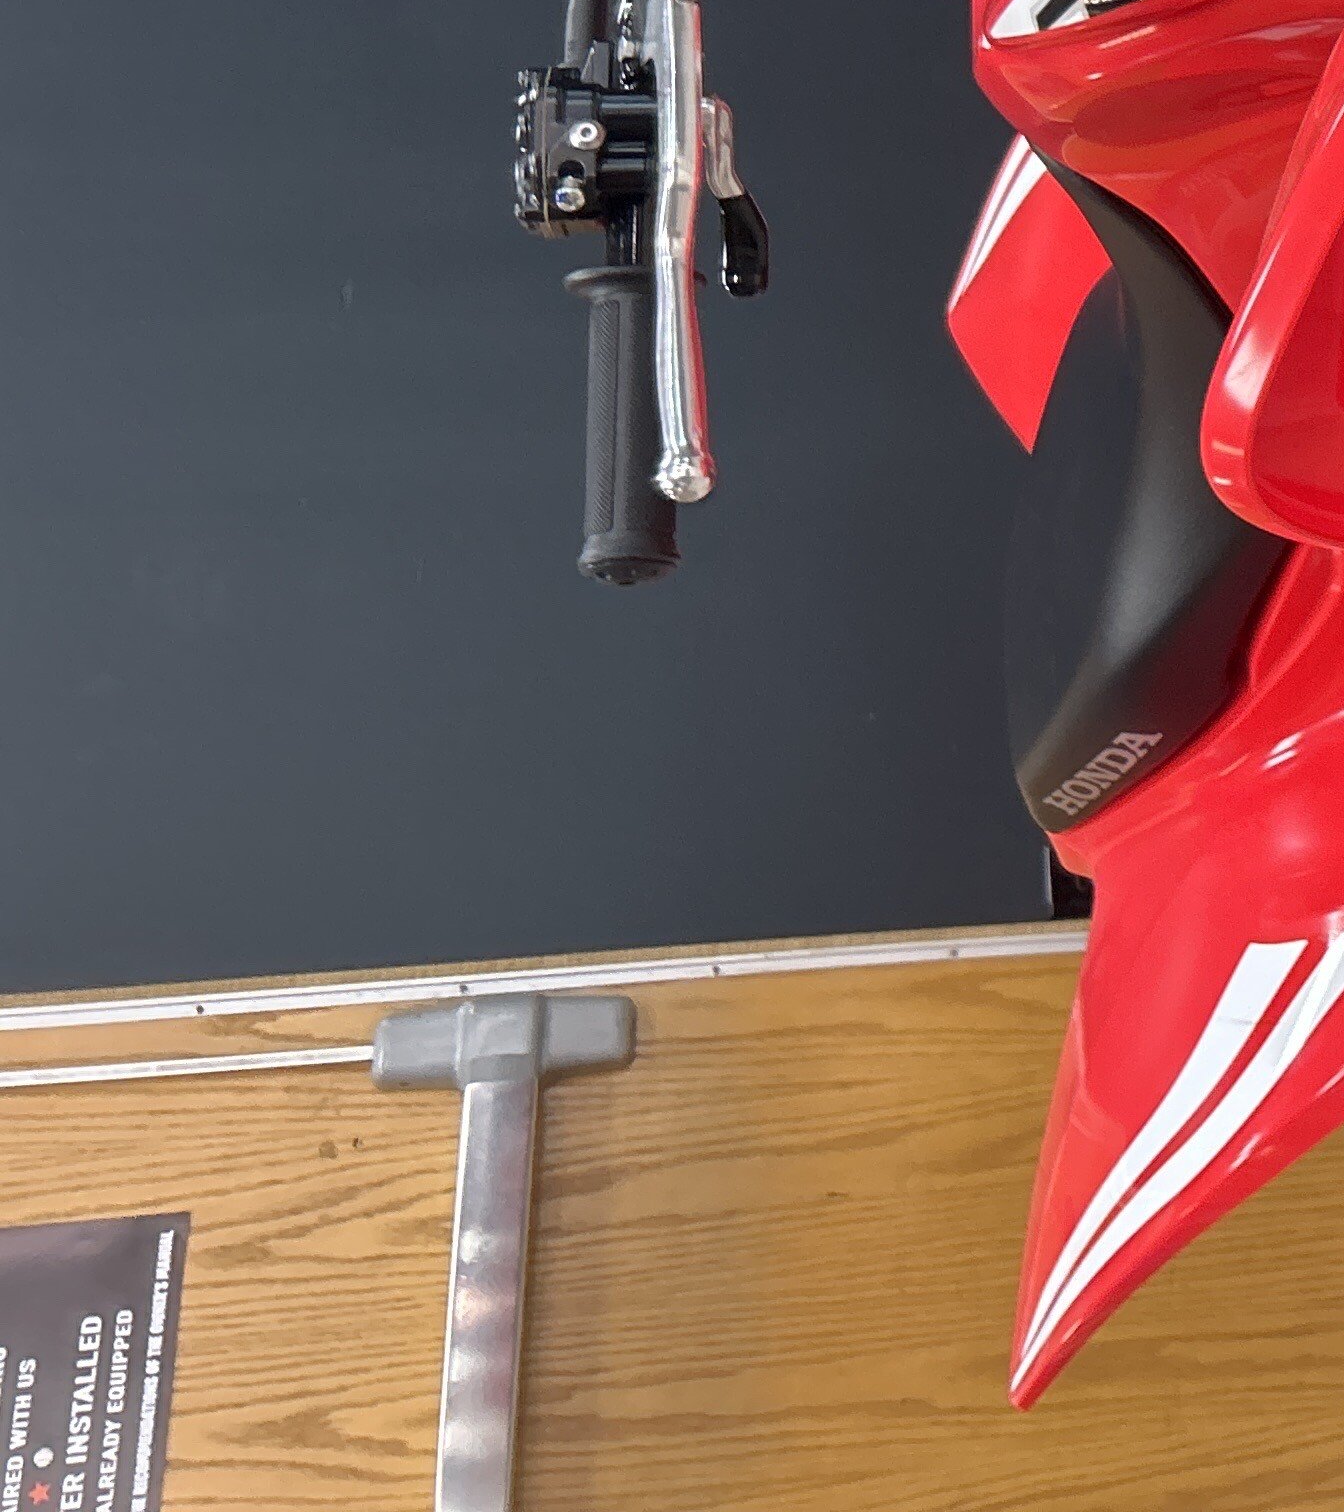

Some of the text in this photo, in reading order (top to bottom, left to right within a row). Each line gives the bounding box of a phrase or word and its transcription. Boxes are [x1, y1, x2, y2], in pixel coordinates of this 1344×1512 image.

[1042, 732, 1163, 816] HONDA
[17, 1358, 36, 1388] US
[147, 1335, 163, 1357] THE
[9, 1394, 32, 1450] WITH
[60, 1316, 103, 1512] ER INSTALLED
[95, 1309, 133, 1512] ALREADY EQUIPPED
